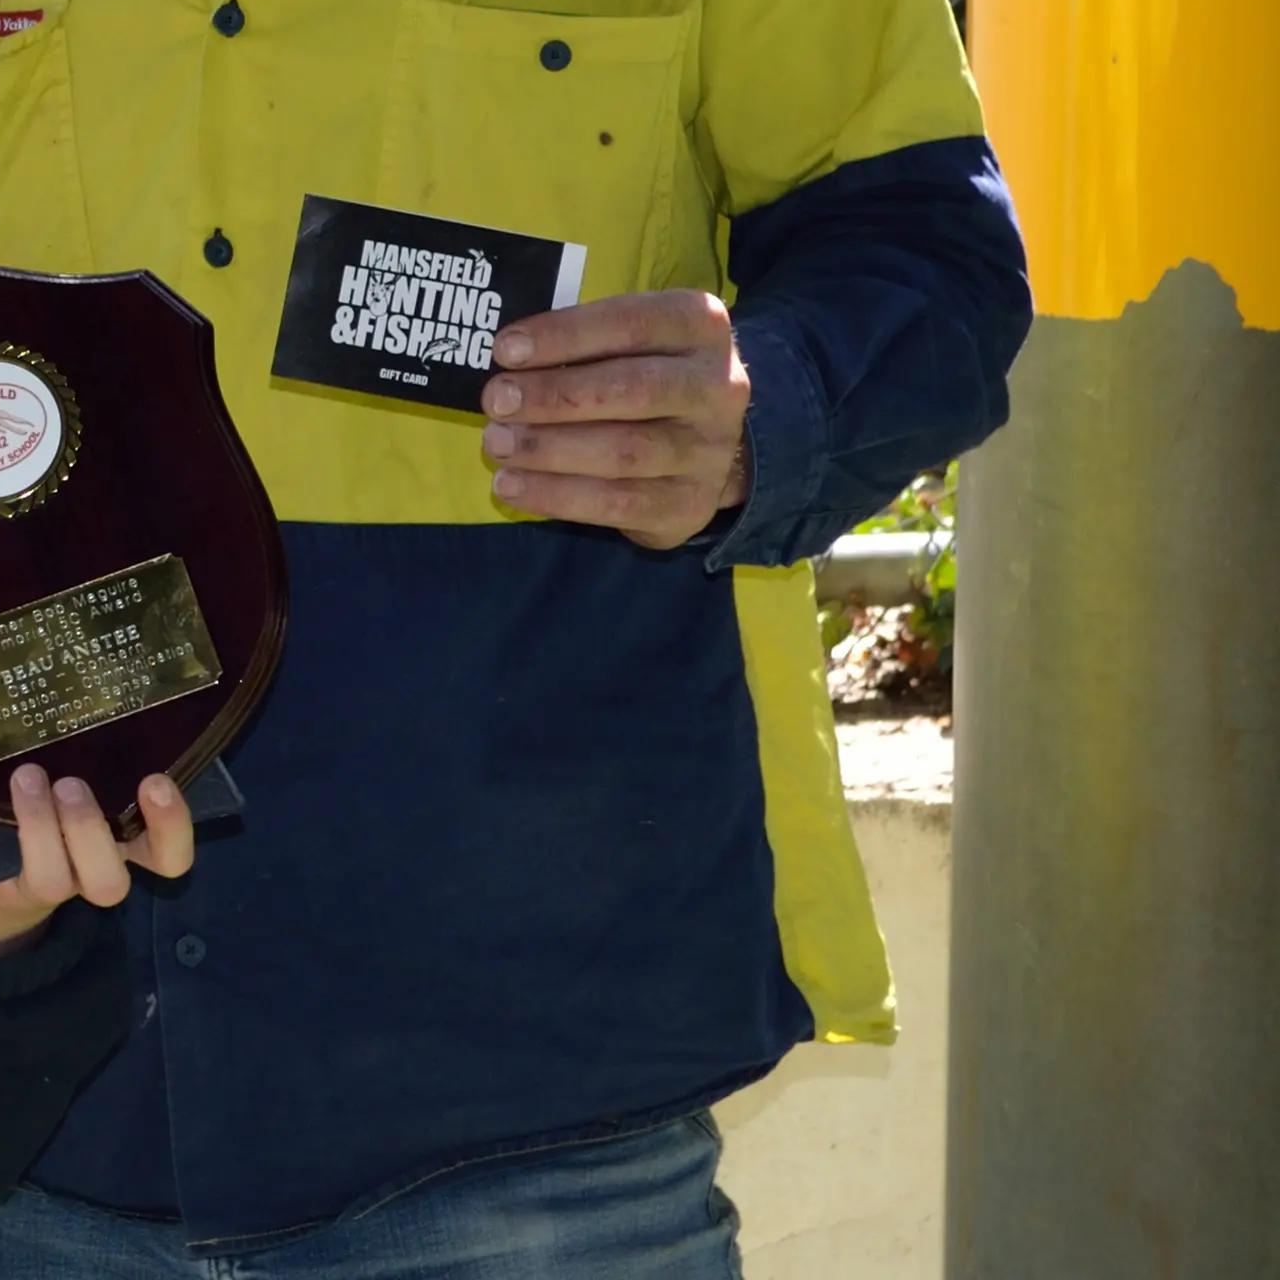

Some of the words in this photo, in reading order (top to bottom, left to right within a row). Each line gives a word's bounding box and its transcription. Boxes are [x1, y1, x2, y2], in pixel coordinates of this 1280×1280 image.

[360, 239, 493, 290] MANSFIELD
[379, 367, 402, 383] GIFT
[402, 371, 429, 387] CARD
[7, 430, 41, 462] SCHOOL
[31, 602, 66, 623] Bob
[72, 576, 139, 610] Maguire
[88, 589, 143, 619] Award
[0, 654, 55, 686] BEAU
[60, 623, 141, 665] ANSTEE
[44, 627, 86, 652] 2025
[7, 677, 48, 699] Care
[74, 641, 145, 675] Concern
[81, 641, 194, 690] Communication
[20, 694, 92, 728] Common
[100, 674, 152, 701] Sense
[55, 694, 145, 735] Community
